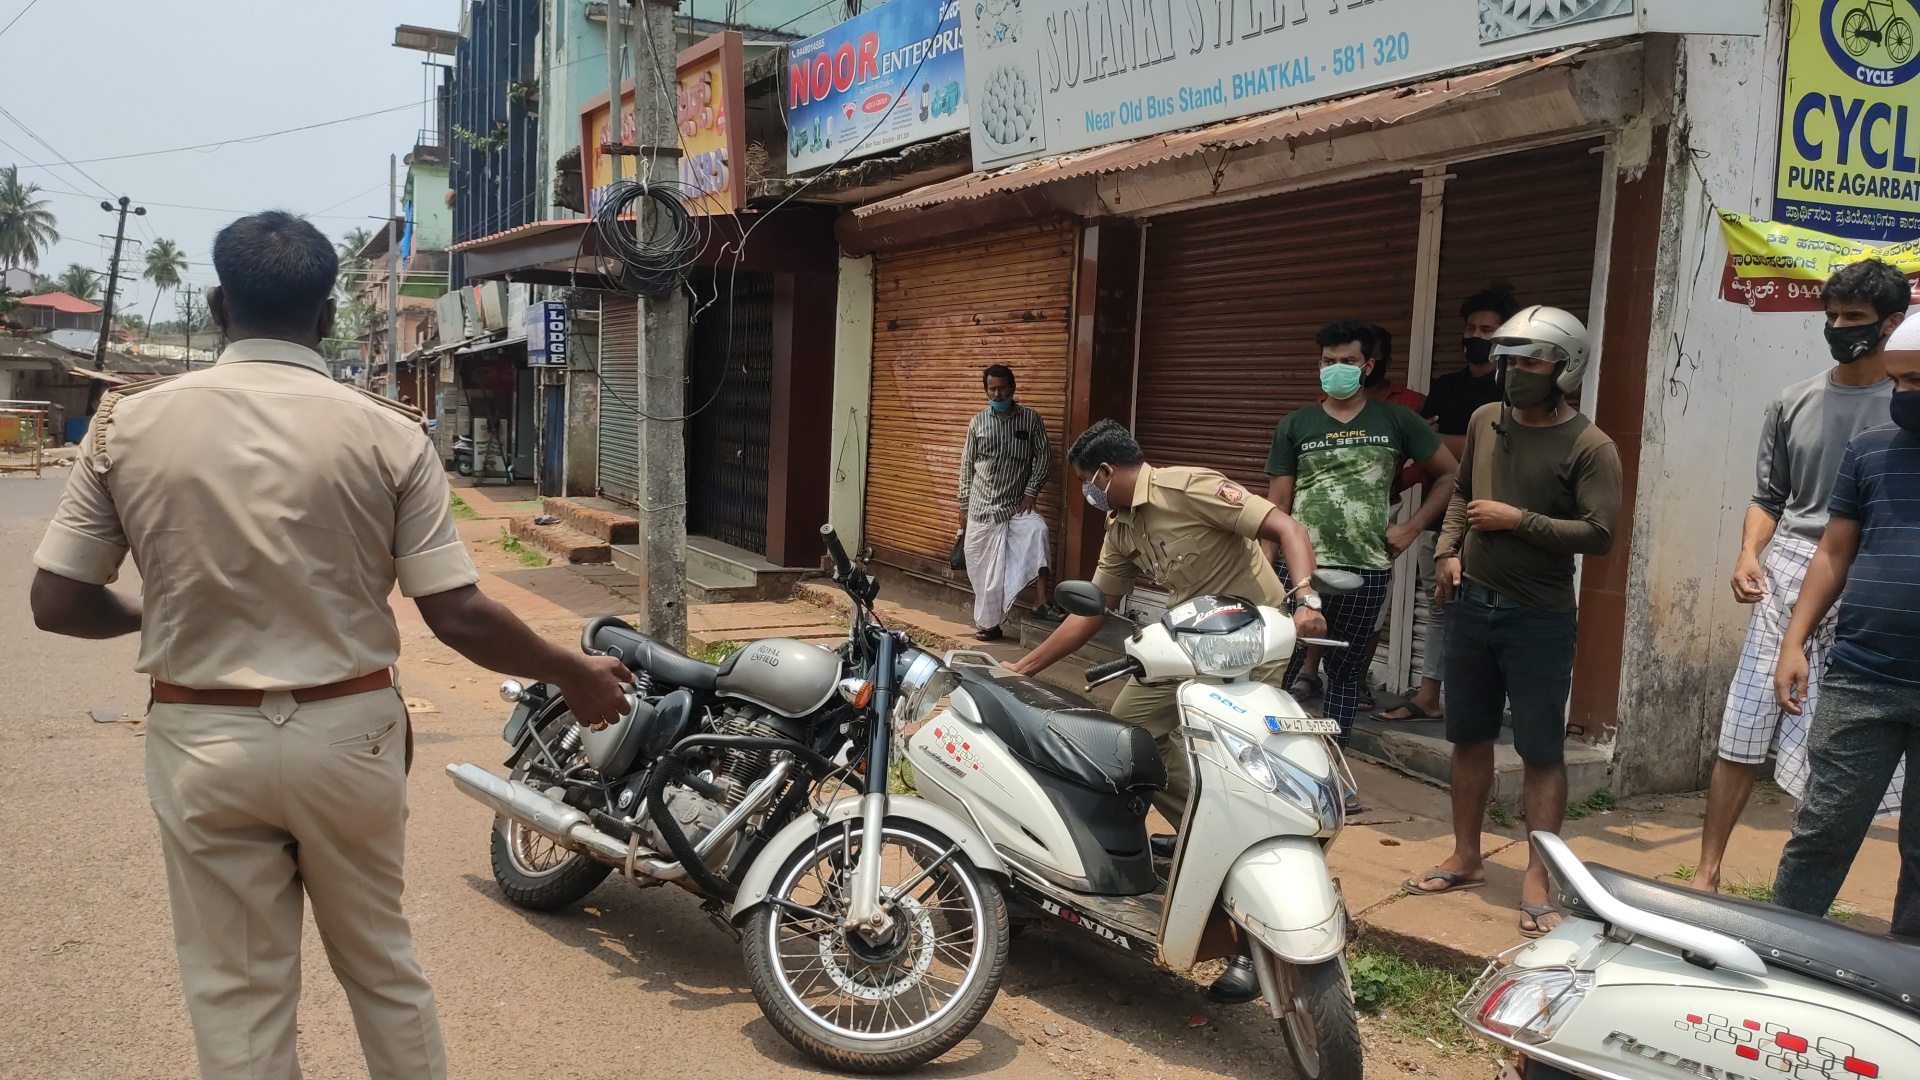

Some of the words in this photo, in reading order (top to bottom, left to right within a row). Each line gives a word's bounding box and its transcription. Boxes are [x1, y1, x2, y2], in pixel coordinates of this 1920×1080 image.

[789, 31, 881, 110] NOOR
[1085, 109, 1115, 133] Near
[1119, 98, 1143, 126] Old
[1147, 95, 1174, 120] Bus
[1178, 78, 1228, 112] Stand,
[1232, 56, 1316, 101] BHATKAL
[1332, 42, 1365, 76] 581
[1373, 31, 1409, 66] 320
[1856, 65, 1895, 85] CYCLE
[1792, 91, 1920, 175] CYCL
[1788, 165, 1834, 193] PURE
[549, 310, 565, 364] LODGE
[1301, 438, 1333, 451] GOAL
[1335, 435, 1389, 446] SETTING
[1325, 429, 1366, 440] PACIFIC
[750, 653, 779, 667] ENFIELD
[757, 644, 781, 657] ROYAL
[1042, 899, 1132, 950] HONDA
